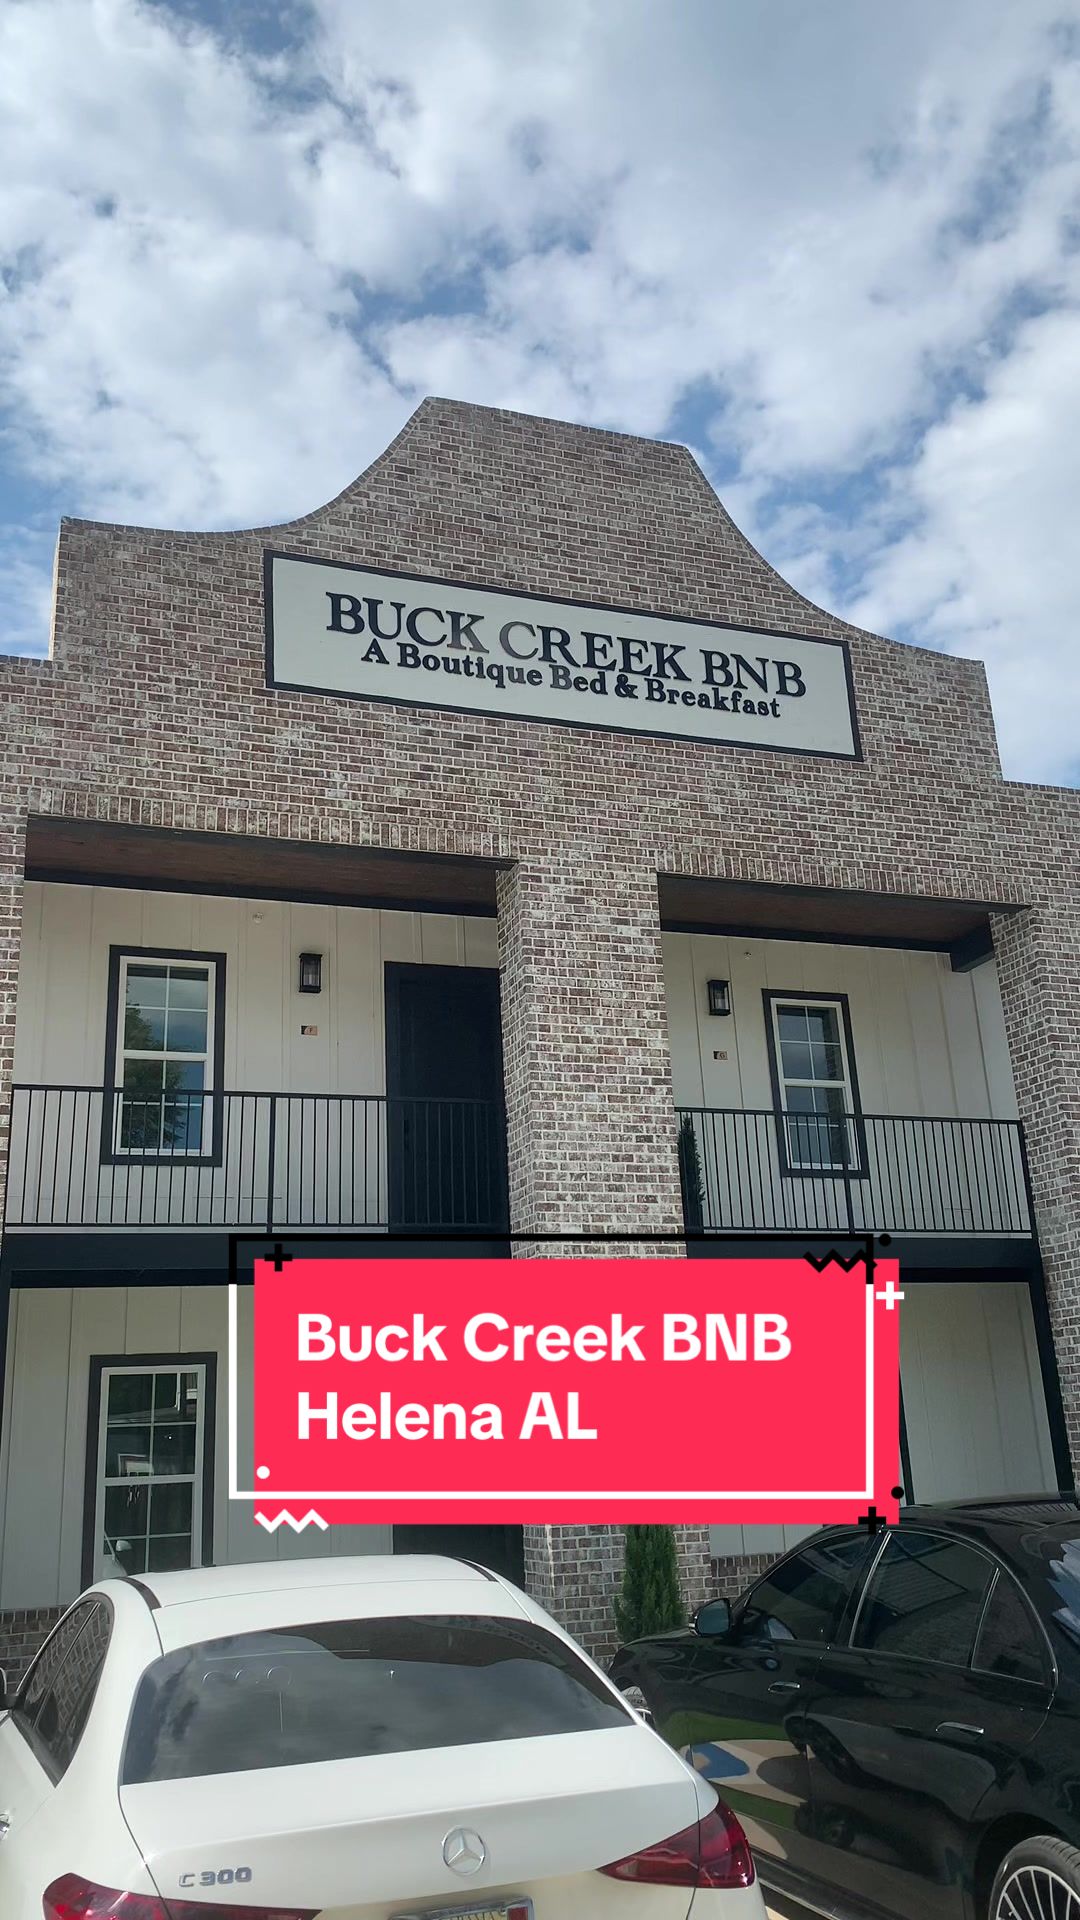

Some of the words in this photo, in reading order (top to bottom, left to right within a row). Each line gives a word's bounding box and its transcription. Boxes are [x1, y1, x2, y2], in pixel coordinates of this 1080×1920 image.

[325, 591, 489, 654] BUCK
[499, 620, 692, 682] CREEK
[699, 648, 807, 697] BNB
[361, 638, 389, 665] A
[396, 641, 543, 689] Boutique
[549, 663, 608, 696] Bed
[614, 673, 639, 700] &
[644, 677, 781, 718] Breakfast
[179, 1873, 195, 1888] C
[199, 1866, 252, 1887] 300
